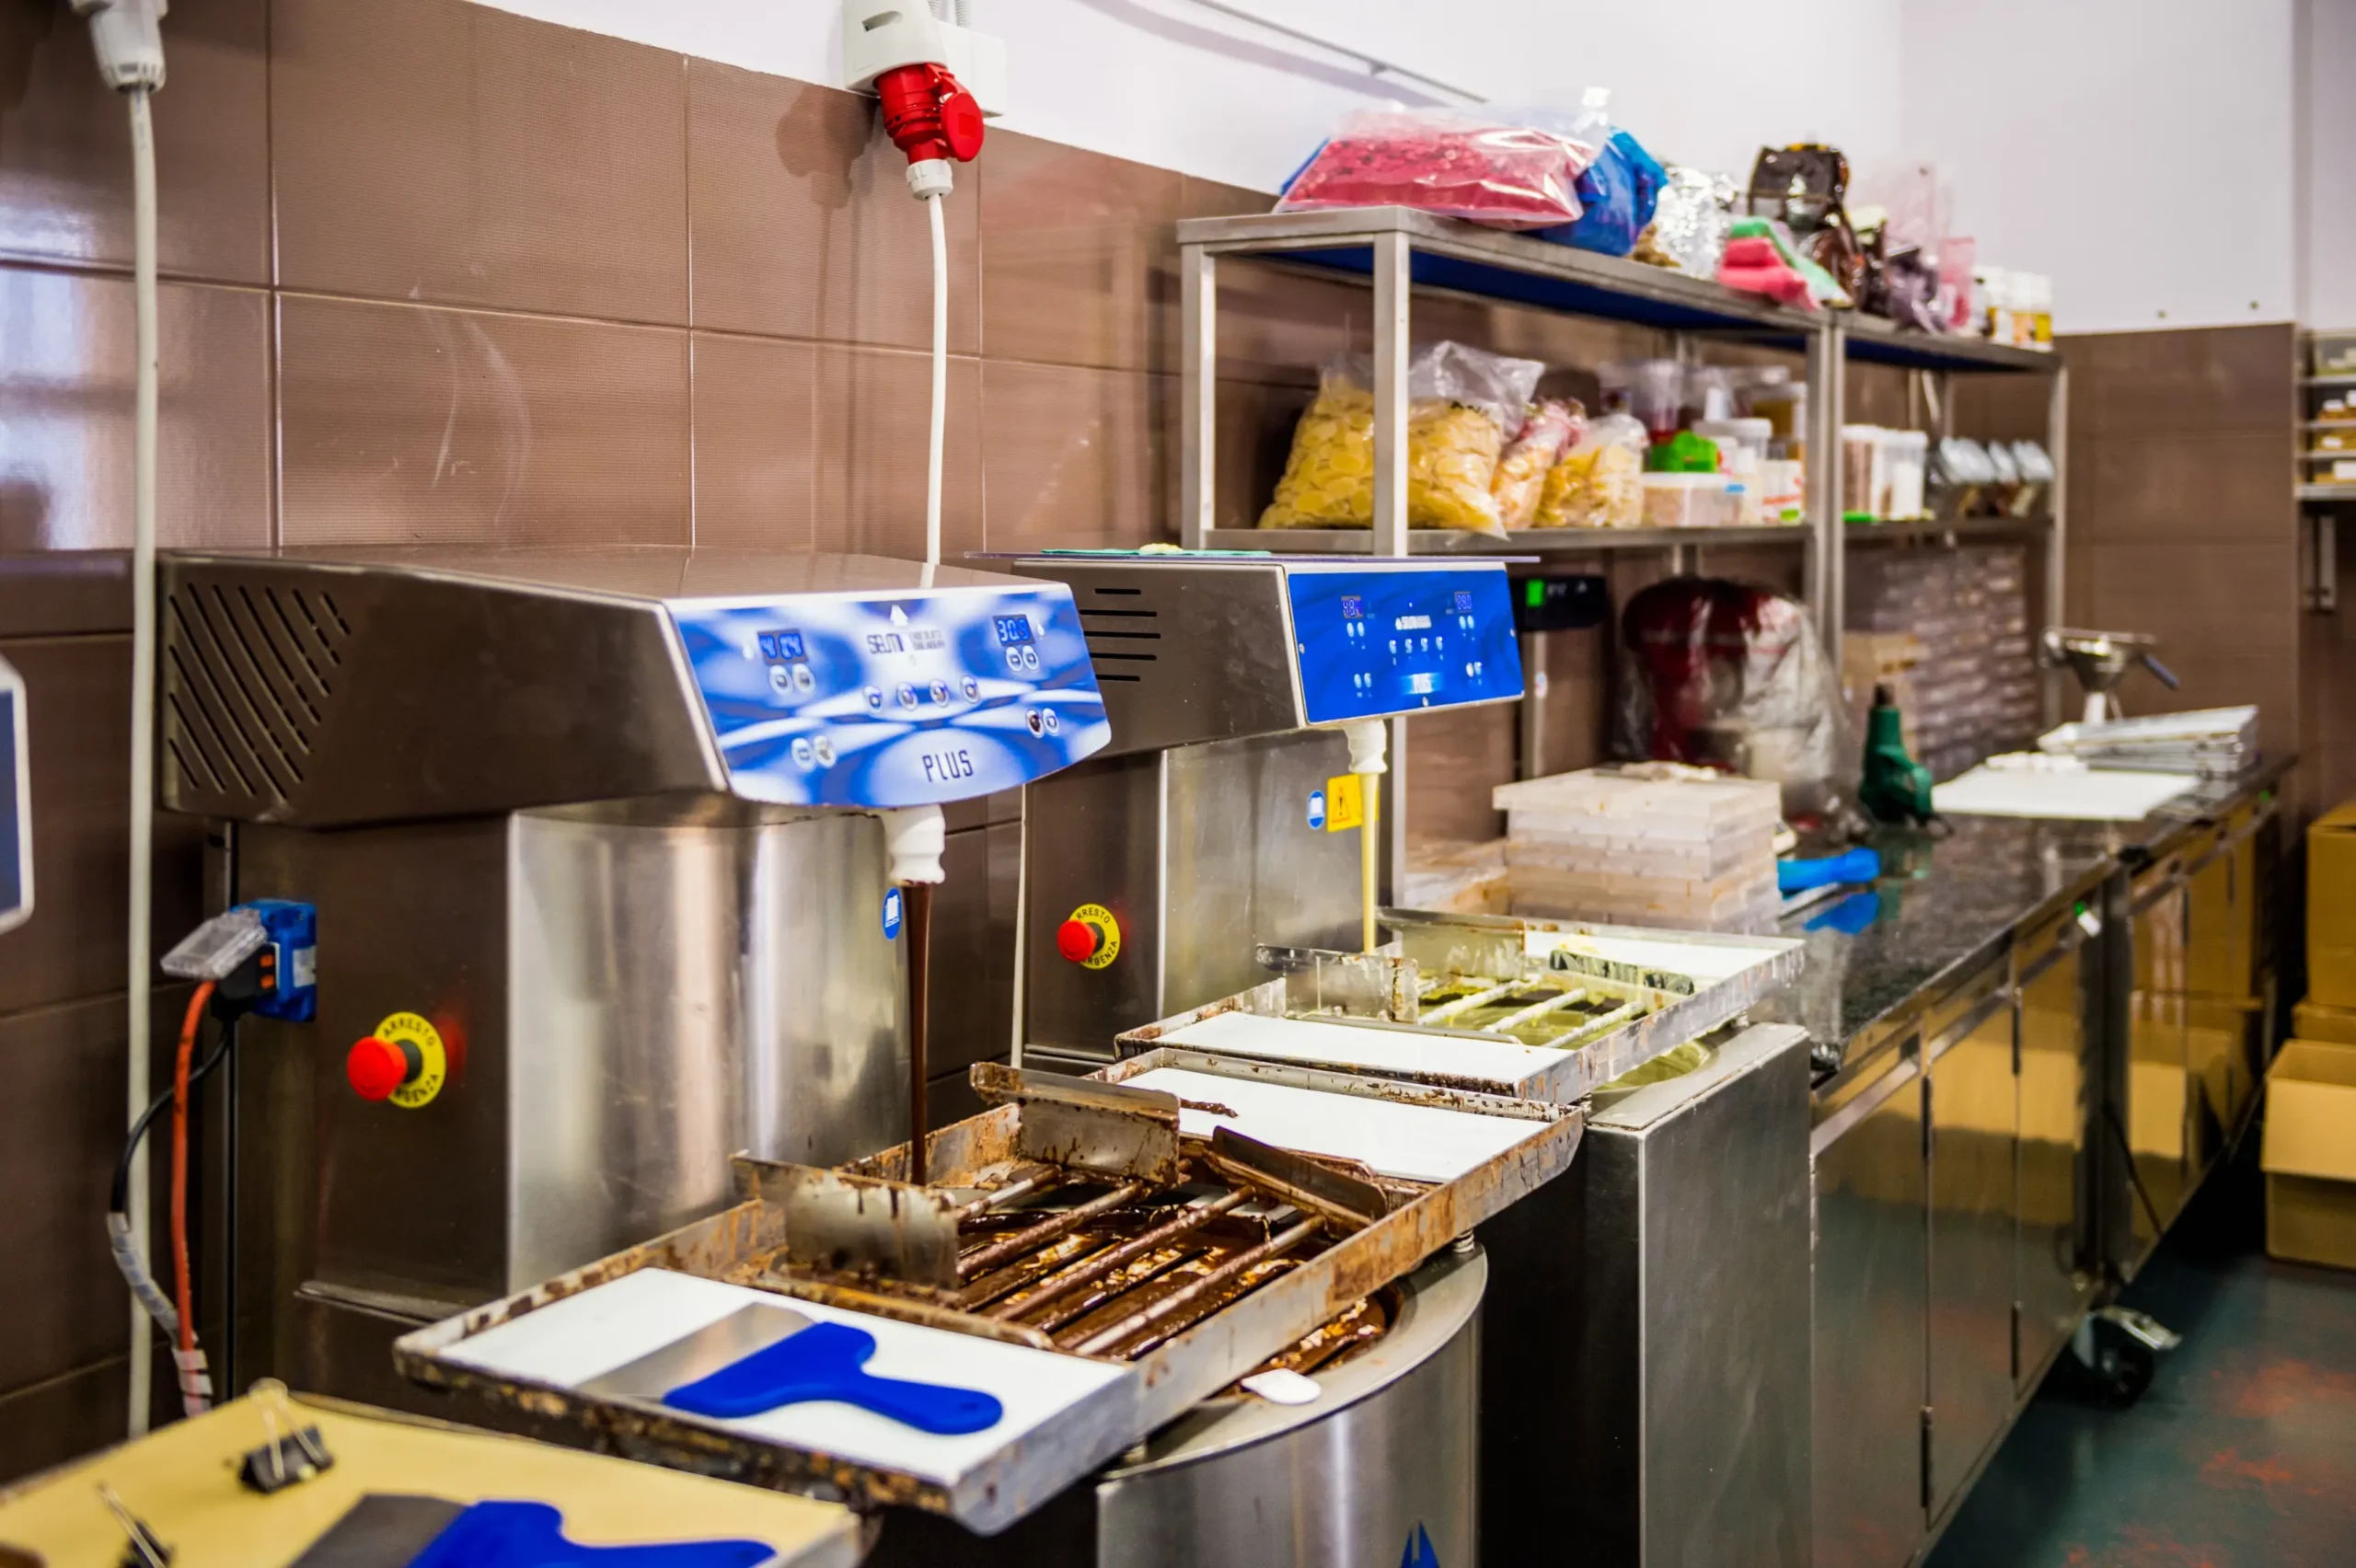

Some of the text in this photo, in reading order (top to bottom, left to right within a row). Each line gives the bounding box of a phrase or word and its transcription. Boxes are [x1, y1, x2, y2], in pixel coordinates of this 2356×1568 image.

[922, 749, 974, 782] PLUS
[1076, 907, 1111, 924] RRESTO
[1087, 940, 1117, 966] RGENZA
